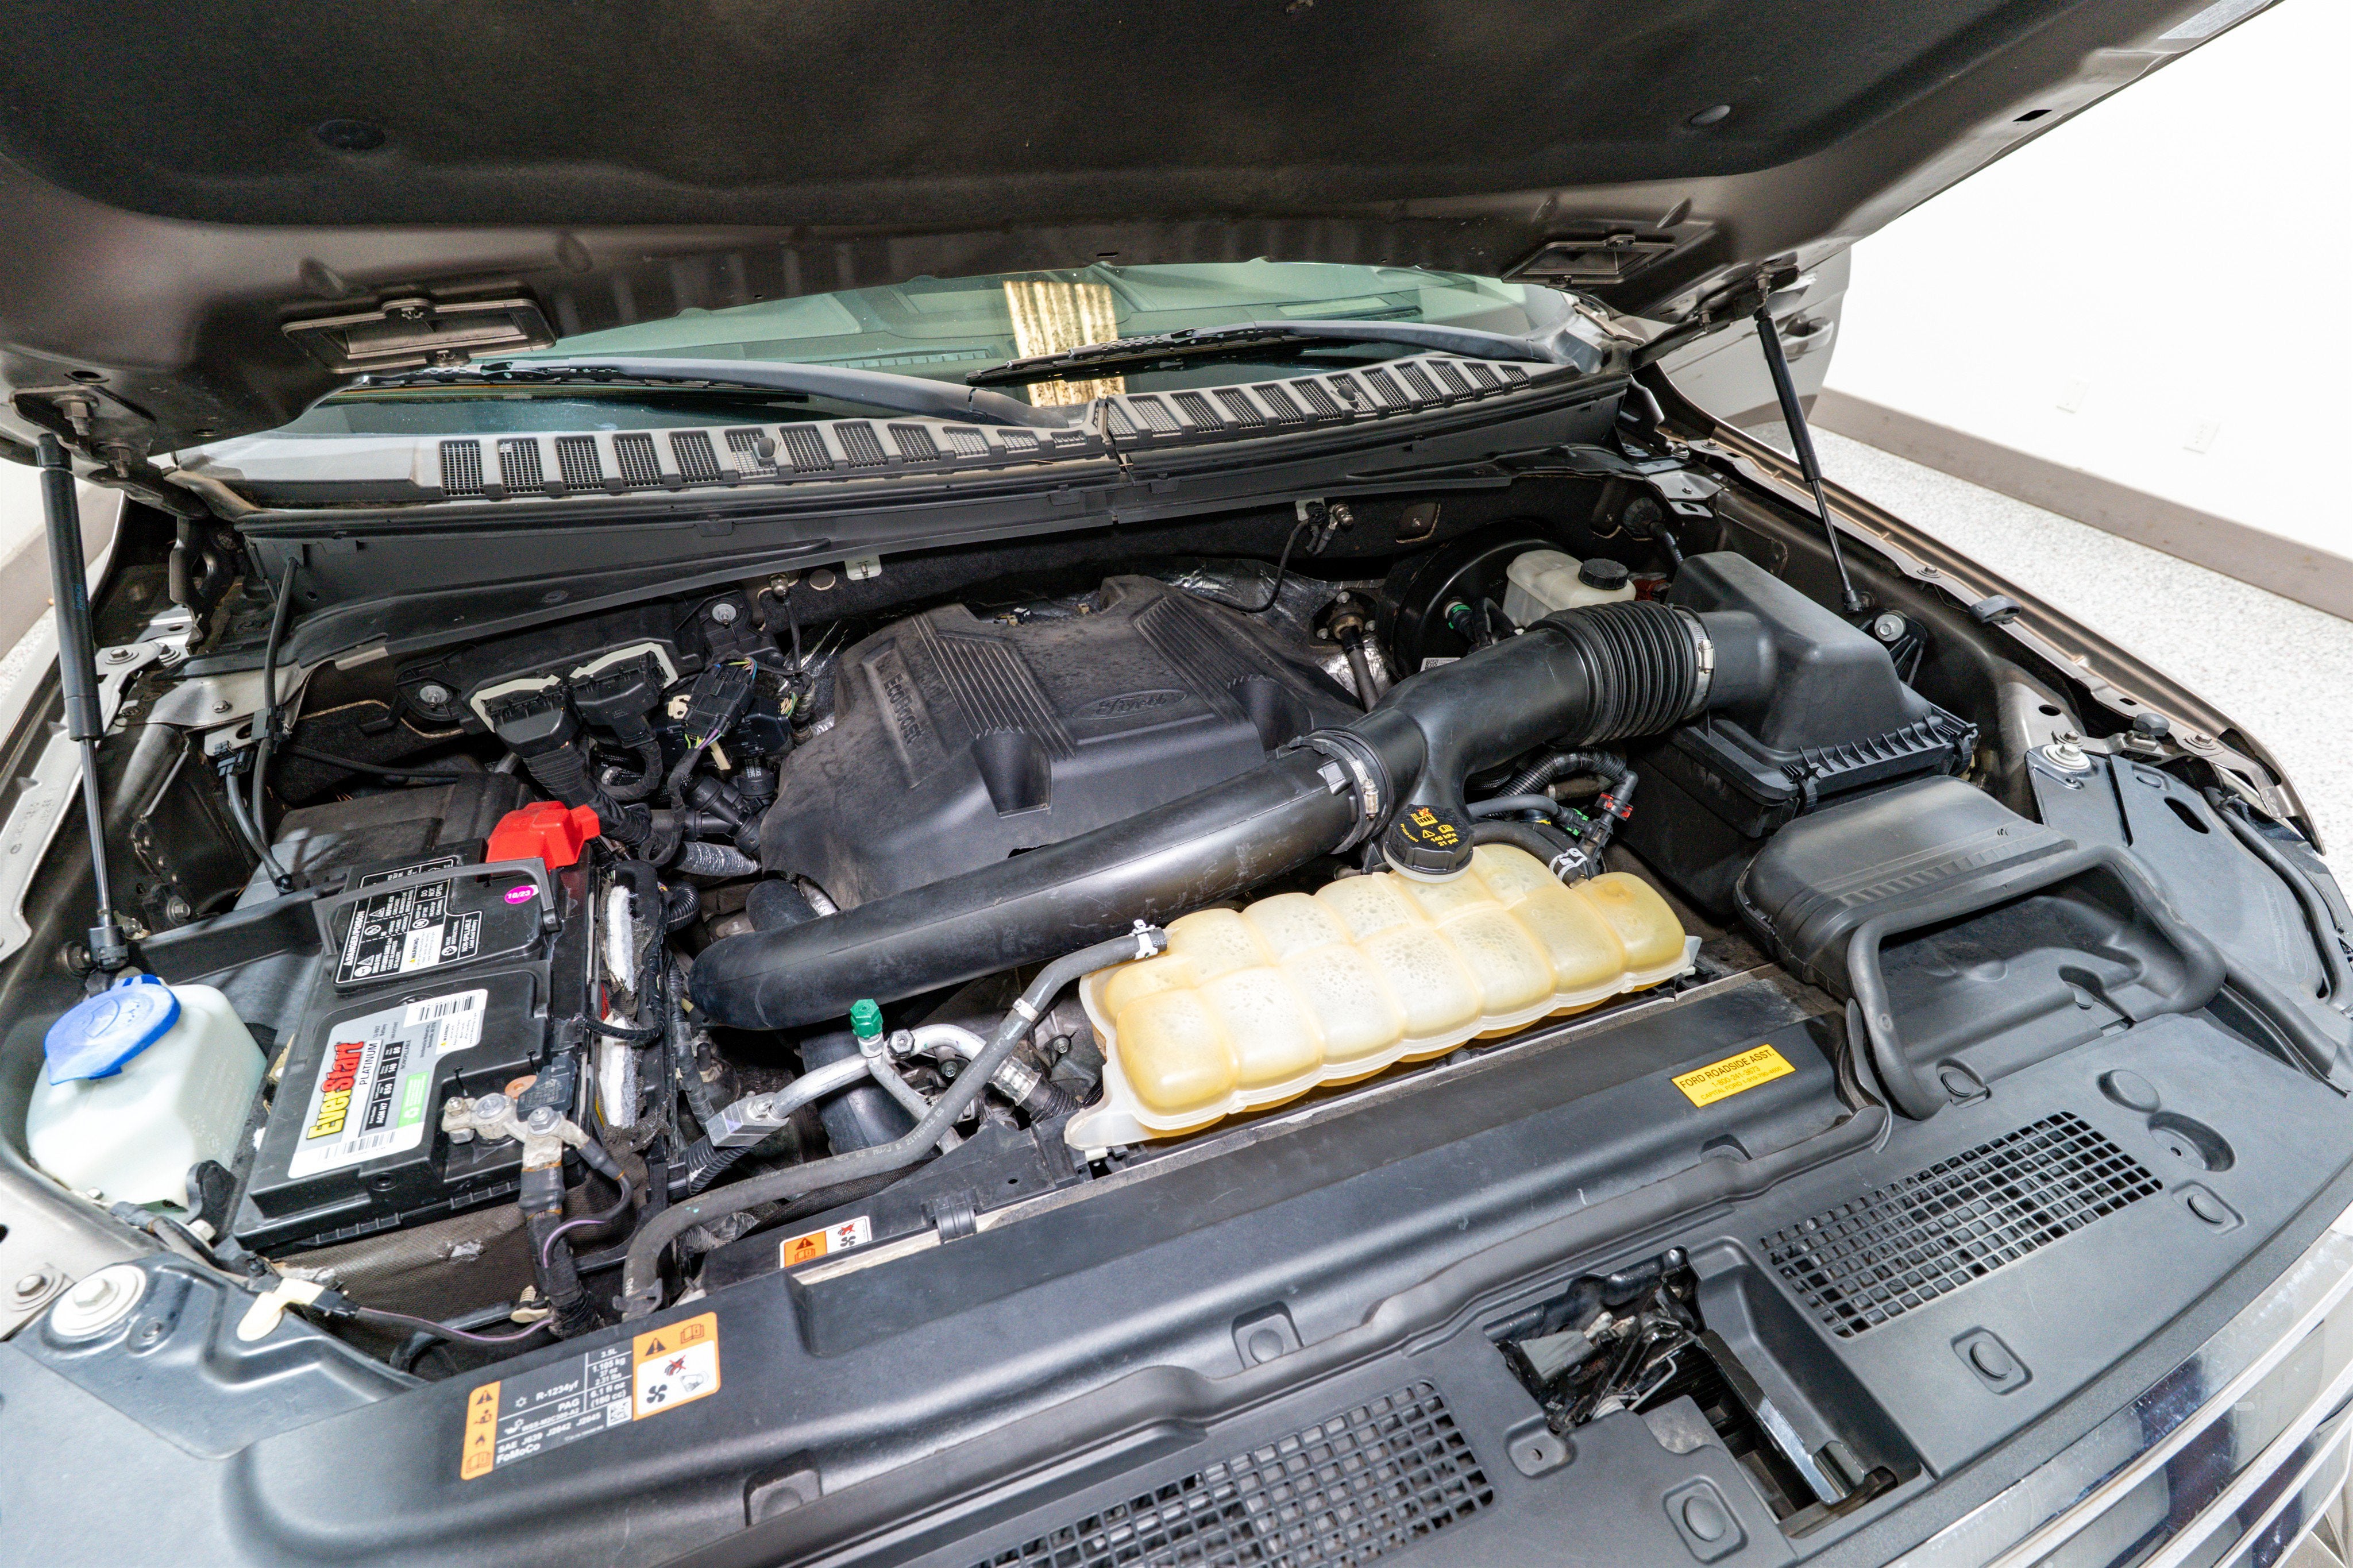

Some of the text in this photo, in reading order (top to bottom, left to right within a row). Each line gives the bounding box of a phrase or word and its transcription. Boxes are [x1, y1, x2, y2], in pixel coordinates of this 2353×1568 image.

[883, 672, 923, 746] EcoBoost
[1095, 693, 1167, 716] Ford
[507, 890, 531, 899] 10/23
[359, 1042, 377, 1085] PLATINUM
[388, 1063, 397, 1073] 140
[1679, 1049, 1774, 1088] FORD ROADSIDE ASST.
[1711, 1065, 1760, 1087] 1-800-241-3673
[306, 1041, 364, 1140] EverStart
[383, 1083, 392, 1095] 850
[1700, 1088, 1726, 1100] CAPITAL
[1724, 1081, 1742, 1090] FORD
[376, 1102, 387, 1123] AGM H7
[905, 1118, 936, 1146] 21:05:02
[935, 1107, 944, 1118] ES
[614, 1357, 626, 1366] kg
[535, 1380, 578, 1400] R-1234yf
[590, 1388, 604, 1398] 6.1
[614, 1381, 625, 1390] oz
[591, 1389, 626, 1408] (180 cc)
[558, 1398, 580, 1411] PAG
[496, 1443, 540, 1463] FoMoCo
[498, 1440, 517, 1453] SAE
